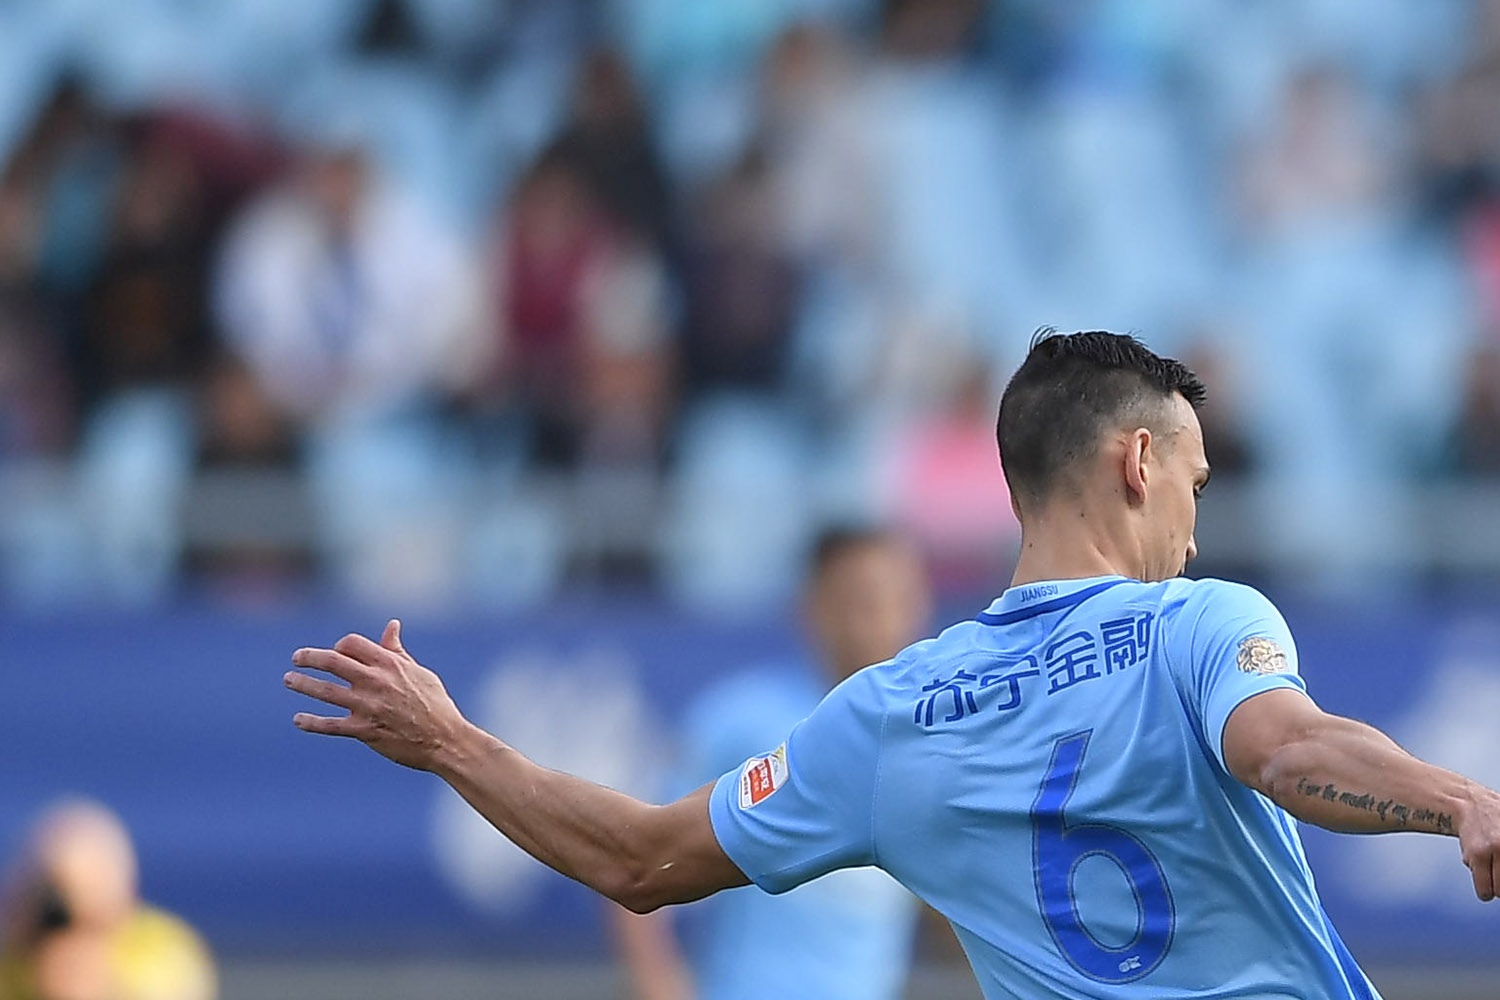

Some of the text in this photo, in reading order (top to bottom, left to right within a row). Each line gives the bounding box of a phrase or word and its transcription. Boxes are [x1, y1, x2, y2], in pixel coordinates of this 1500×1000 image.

[1020, 585, 1059, 602] JIANGSU
[913, 611, 1155, 727] 苏宁金融
[1377, 799, 1393, 822] of
[1030, 727, 1177, 986] 6
